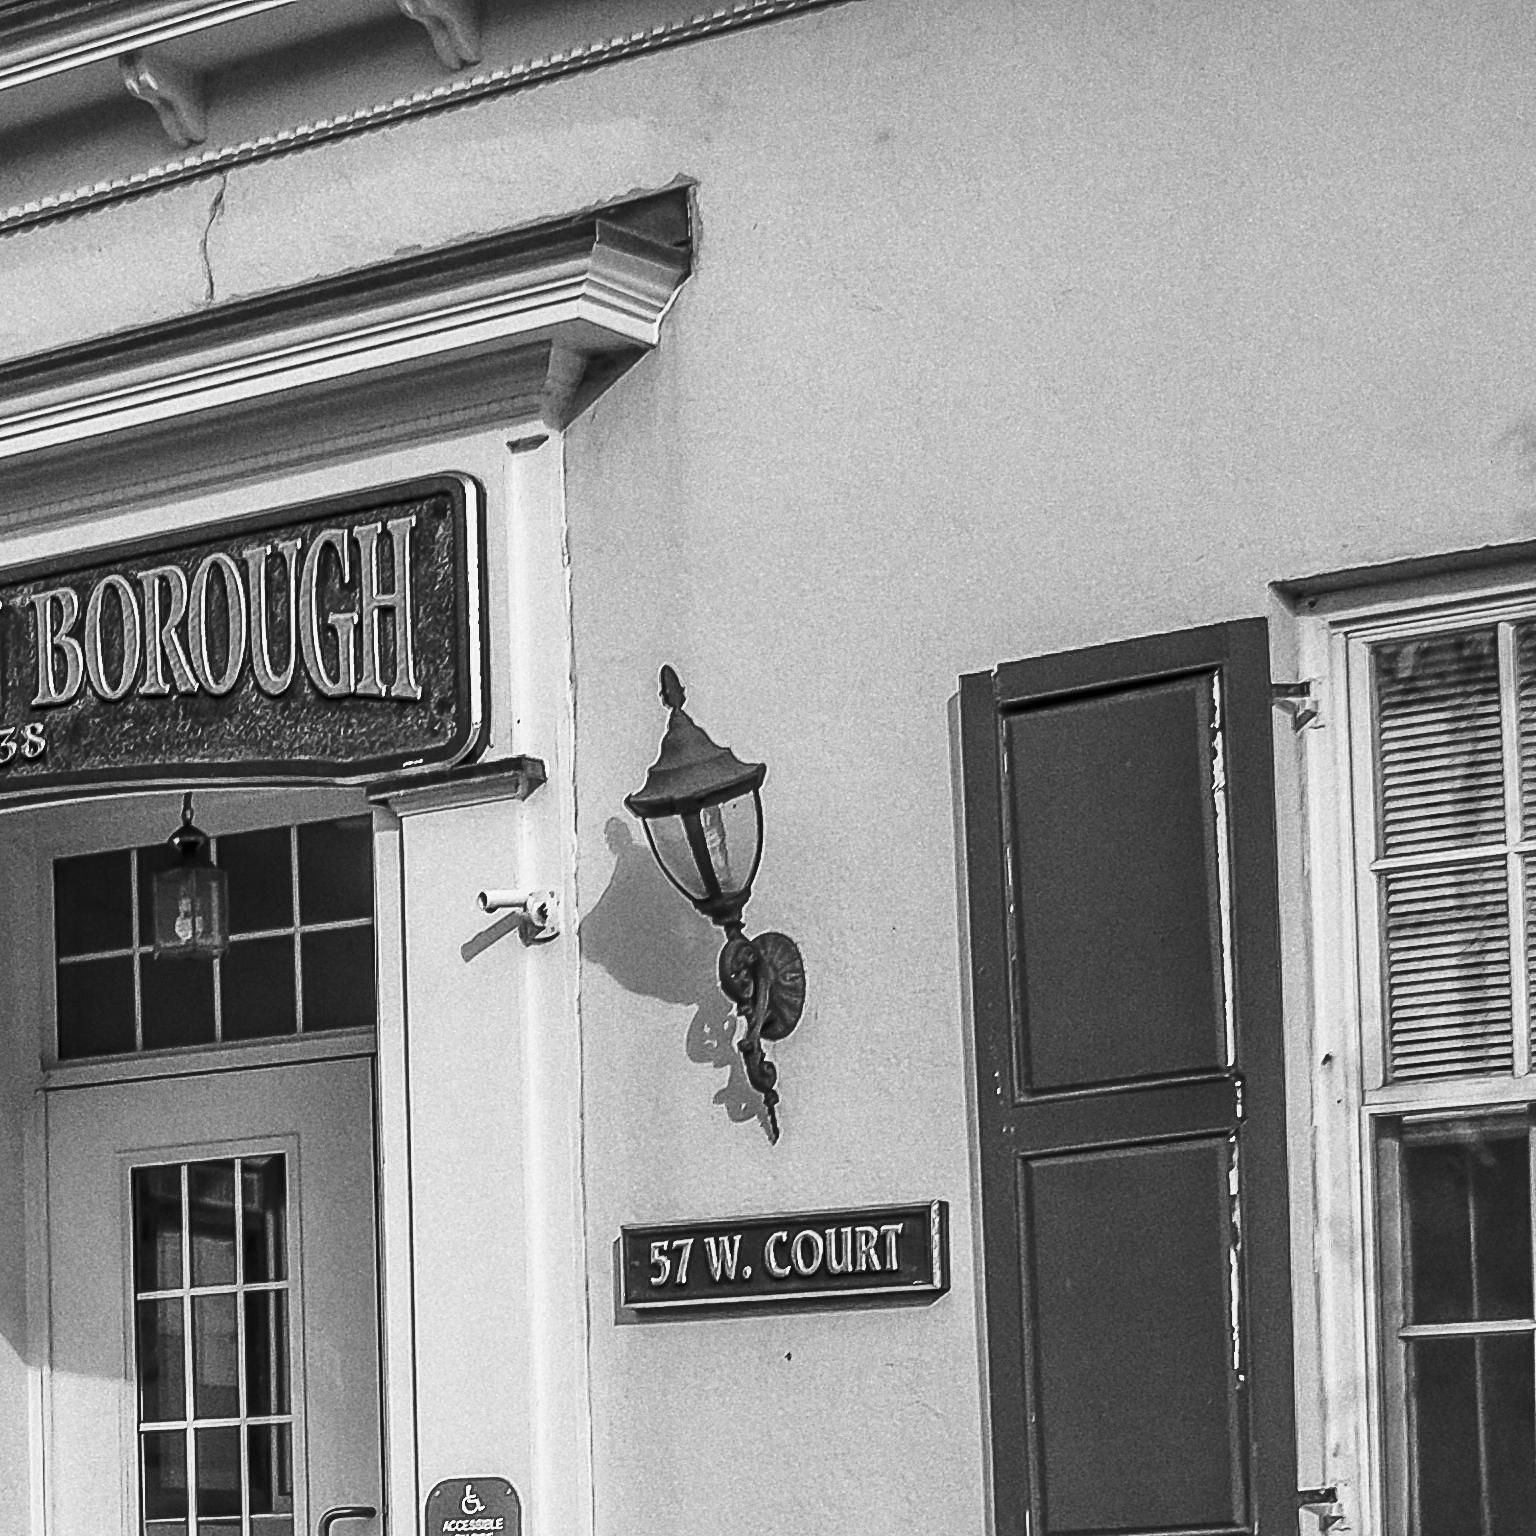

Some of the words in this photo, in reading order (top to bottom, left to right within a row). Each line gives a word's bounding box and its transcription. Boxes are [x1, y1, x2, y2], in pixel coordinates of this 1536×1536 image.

[31, 513, 423, 708] BOROUGH
[650, 1237, 694, 1287] 57
[704, 1234, 752, 1283] W.
[764, 1223, 904, 1279] COURT
[442, 1517, 504, 1532] ACCESSIBLE
